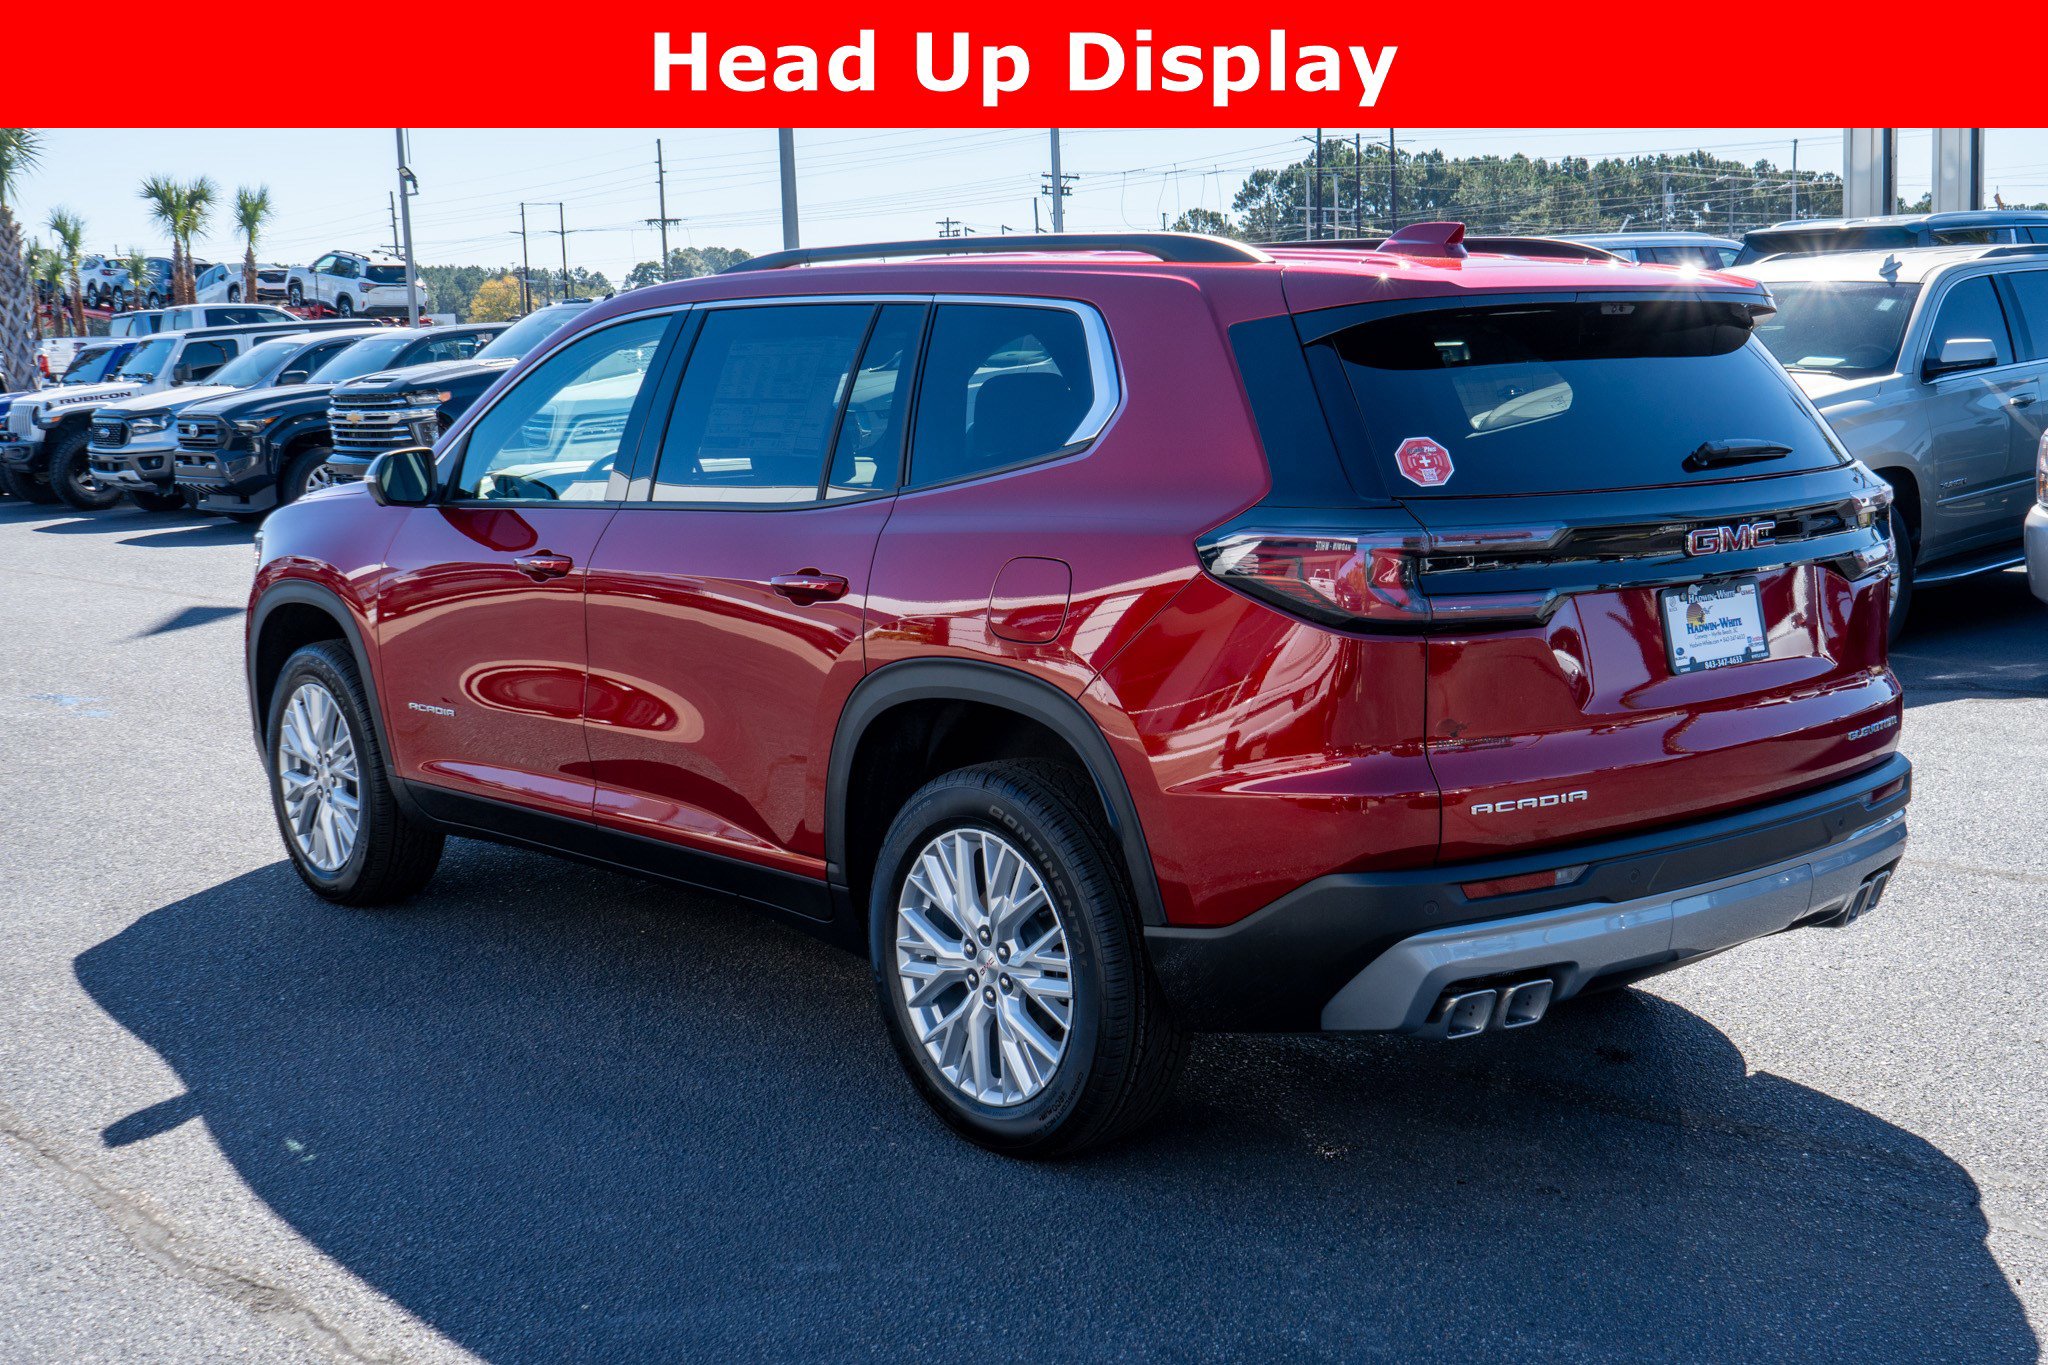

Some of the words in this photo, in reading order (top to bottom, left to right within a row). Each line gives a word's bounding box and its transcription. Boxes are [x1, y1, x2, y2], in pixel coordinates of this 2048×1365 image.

[60, 391, 132, 404] RUBICON
[1687, 521, 1776, 556] GMC
[1704, 655, 1743, 669] 843-347-4633
[408, 702, 455, 717] ACADIA
[1848, 715, 1898, 741] ELEVATION
[1470, 790, 1588, 815] ACADIA
[988, 804, 1088, 977] CONTINENTAL
[980, 957, 995, 976] GMC
